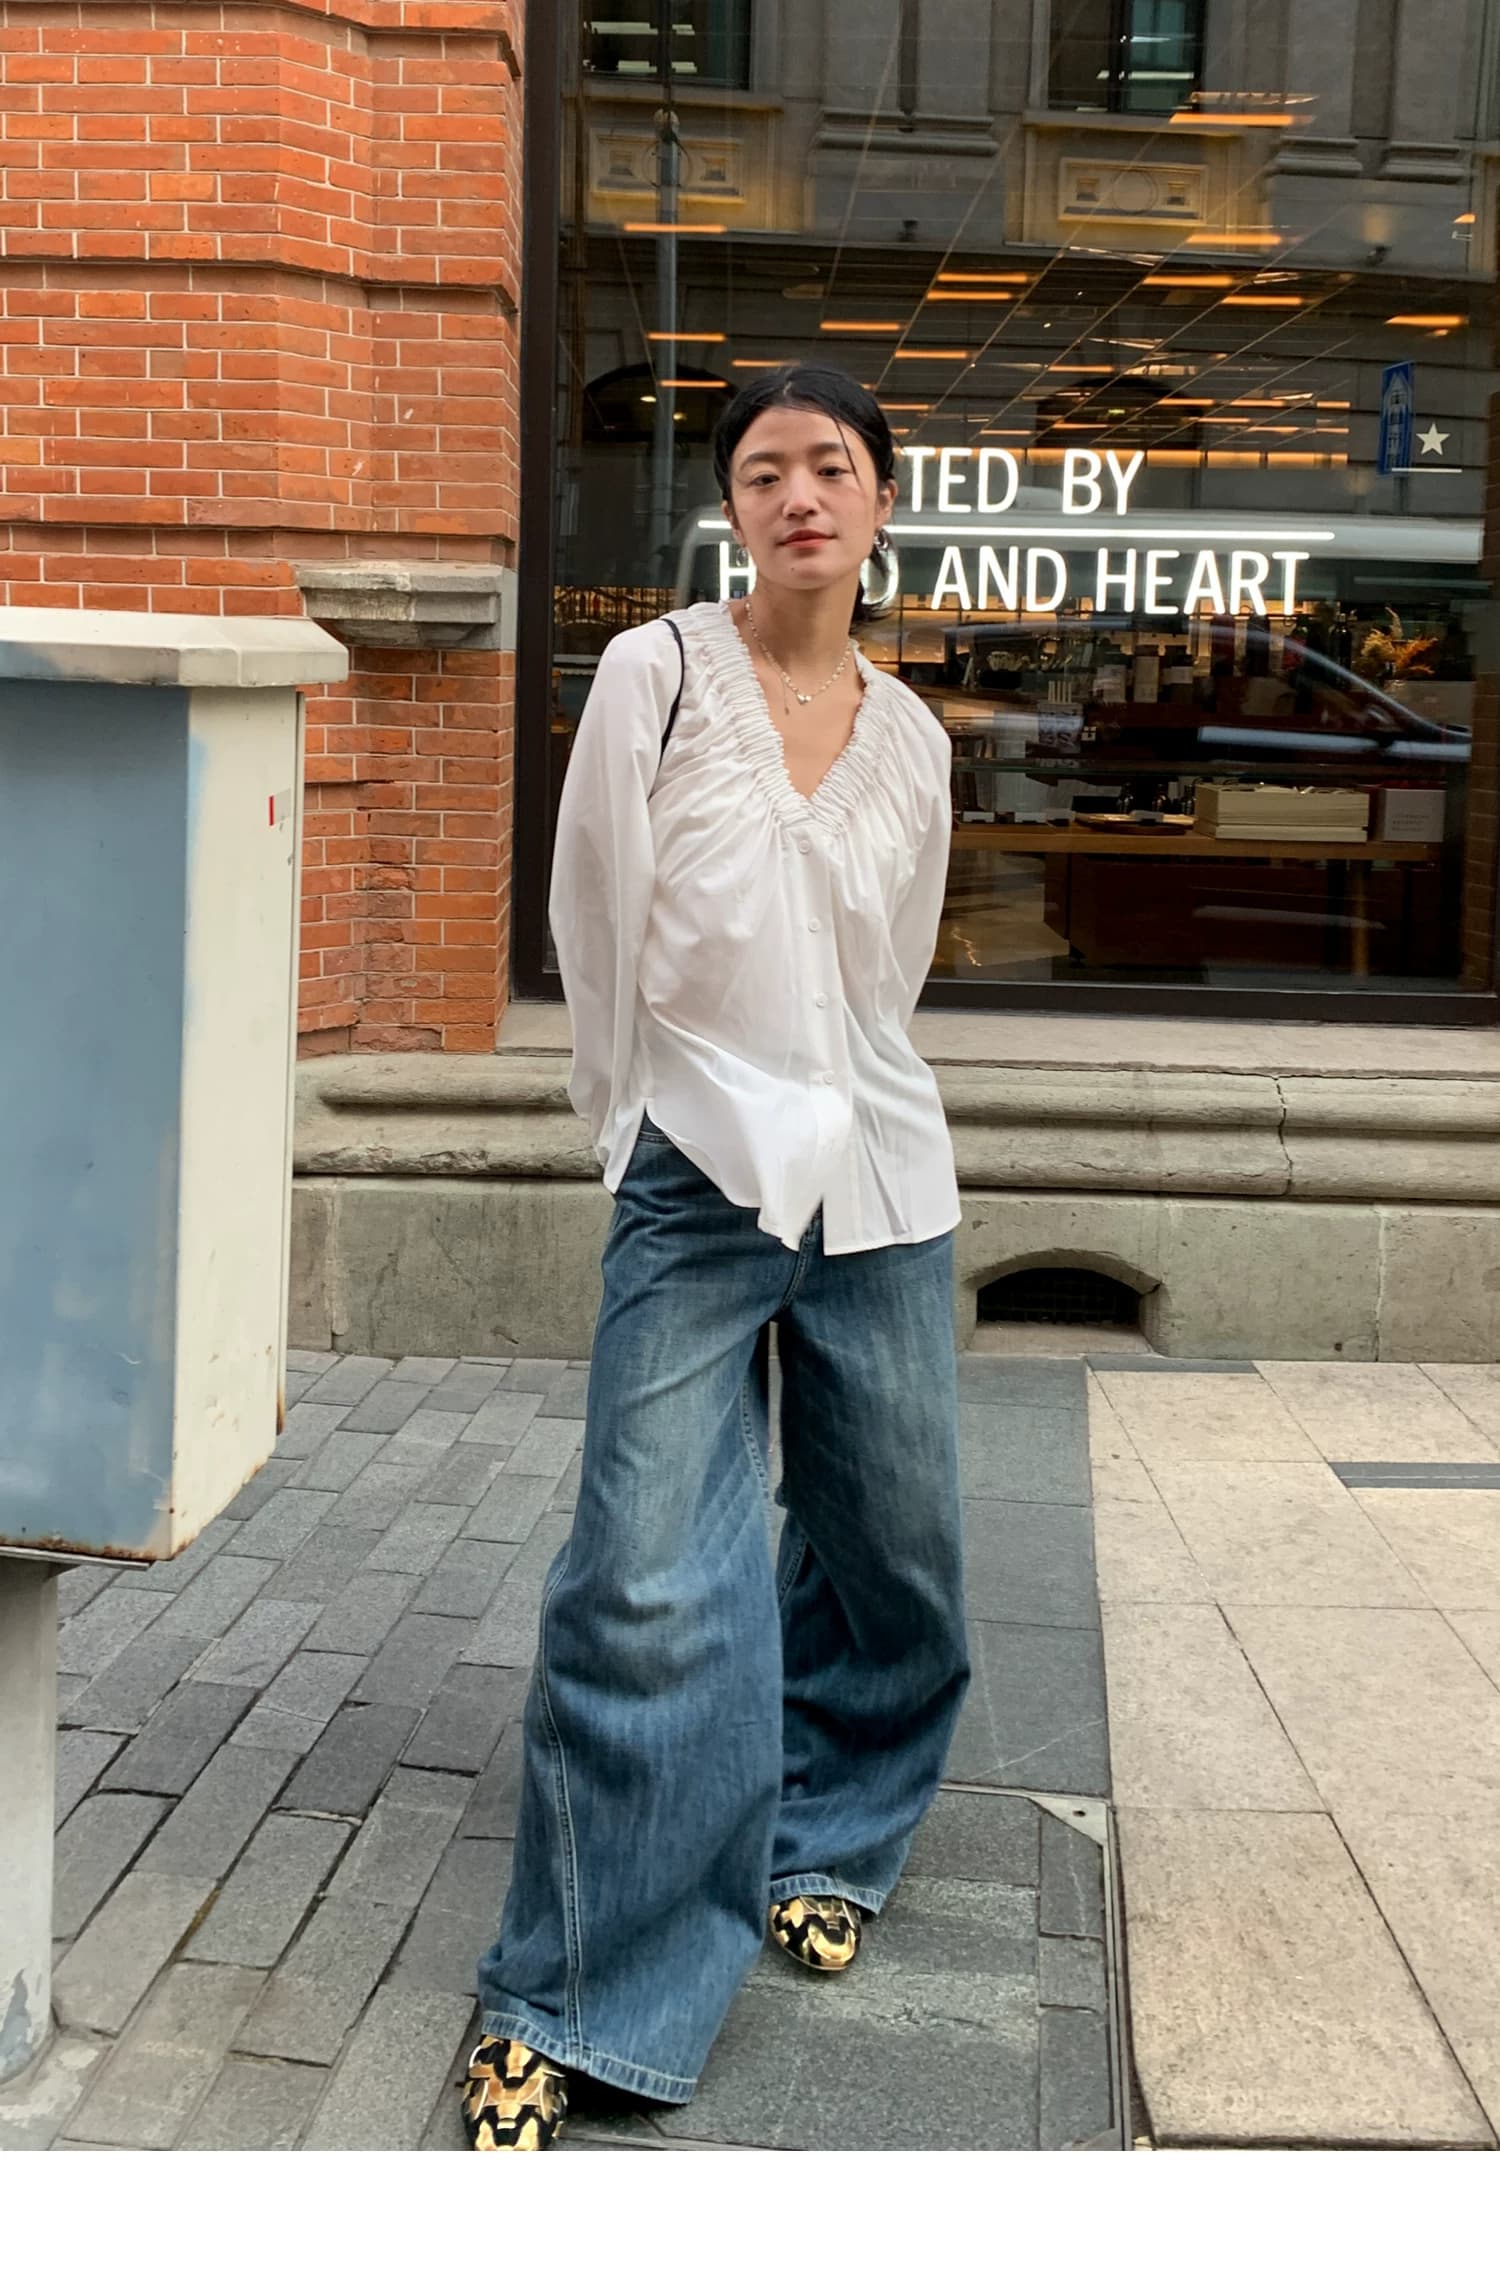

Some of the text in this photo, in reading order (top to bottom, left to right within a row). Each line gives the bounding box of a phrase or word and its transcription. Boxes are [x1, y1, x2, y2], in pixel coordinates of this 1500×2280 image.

[900, 446, 1145, 516] TED BY
[719, 540, 1310, 617] HD AND HEART
